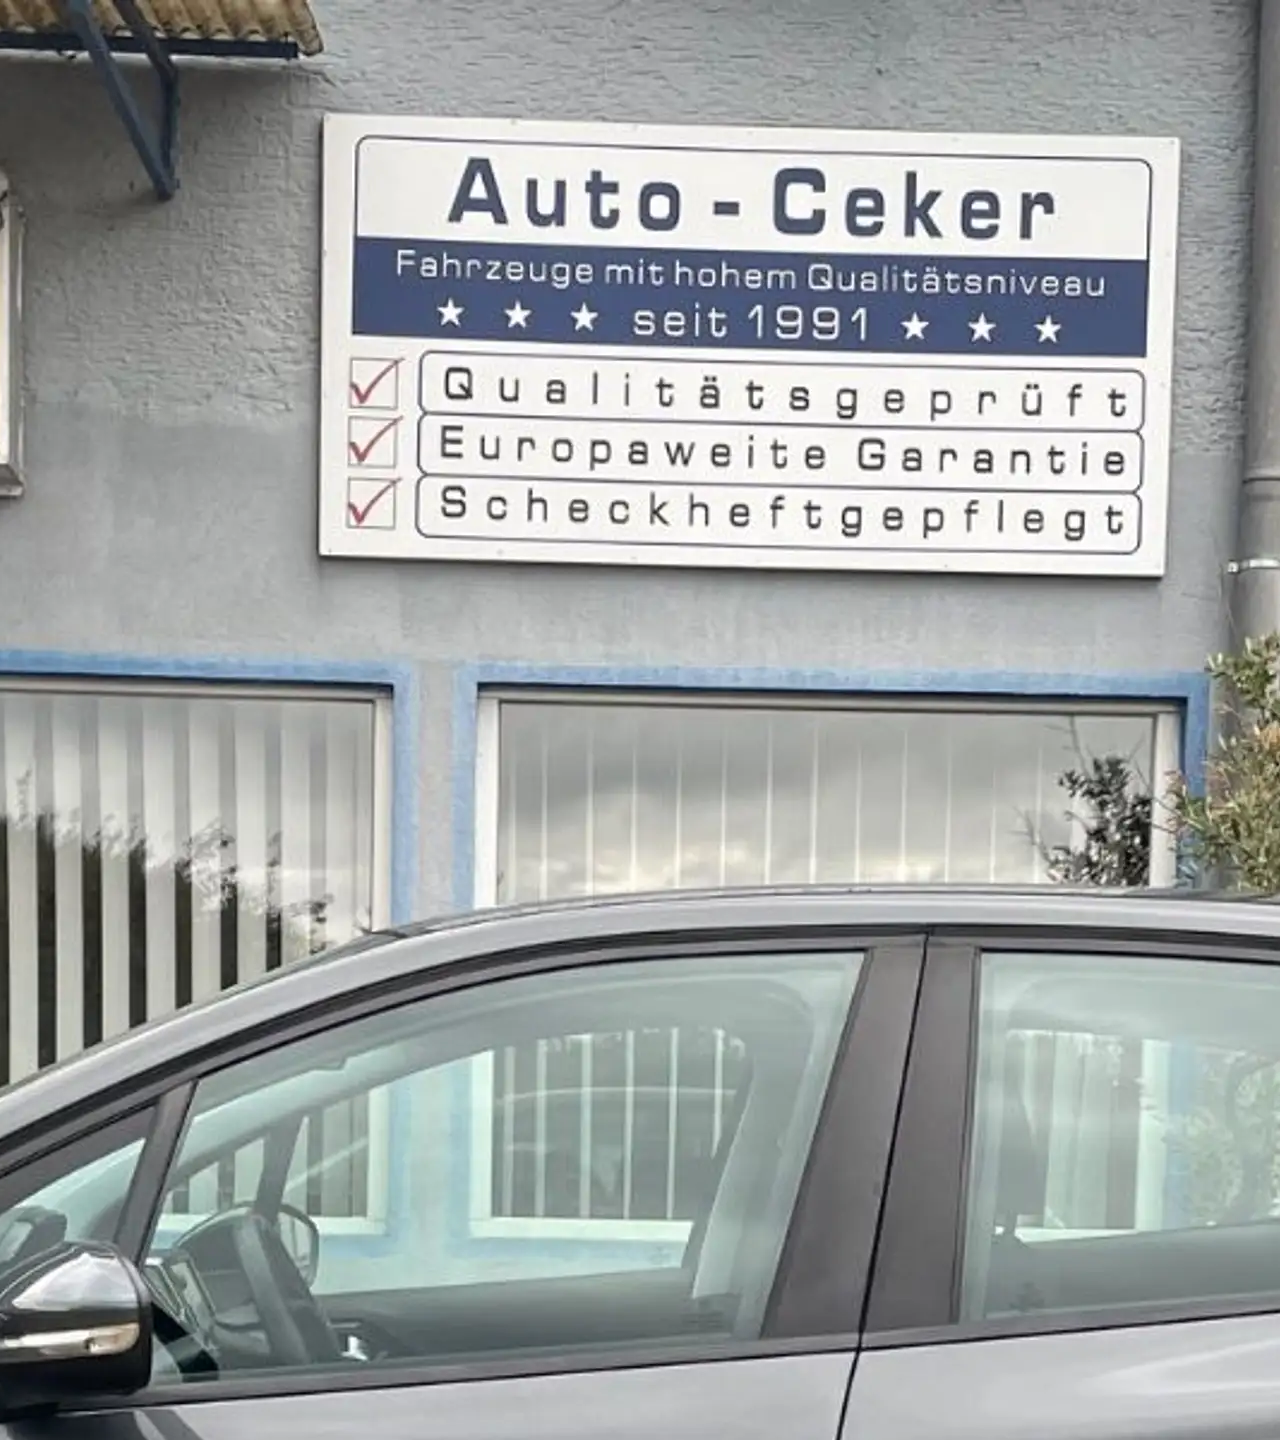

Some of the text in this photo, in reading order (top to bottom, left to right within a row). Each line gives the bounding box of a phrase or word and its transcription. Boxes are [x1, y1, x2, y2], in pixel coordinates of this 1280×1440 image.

[447, 157, 681, 232] Auto
[773, 167, 1055, 240] Ceker
[396, 250, 1105, 298] Fahrzeuge mit hohem Qualitätsniveau
[633, 302, 869, 342] seit 1991
[442, 366, 1128, 421] Qualitätsgeprüft
[440, 425, 1127, 477] Europaweite Garantie
[440, 486, 1126, 538] Scheckheftgepflegt
